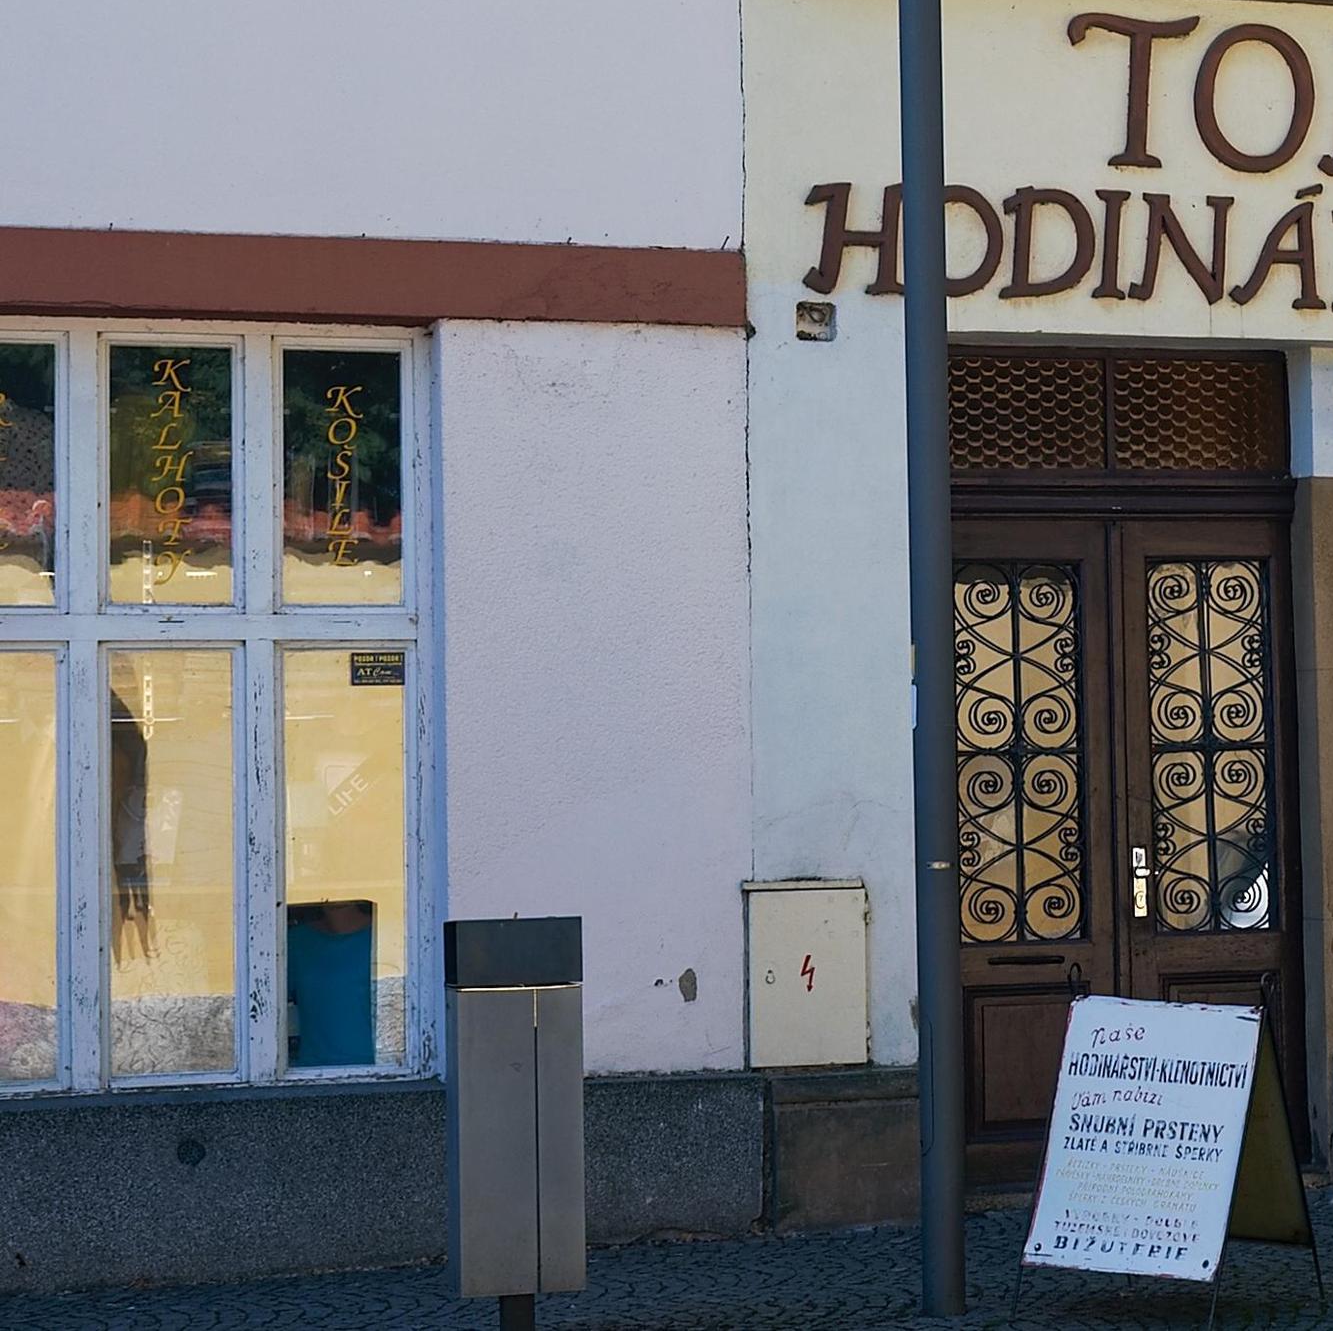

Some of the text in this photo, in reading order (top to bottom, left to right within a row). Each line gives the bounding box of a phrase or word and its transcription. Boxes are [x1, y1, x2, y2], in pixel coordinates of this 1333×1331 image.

[151, 358, 193, 586] KALHOTY
[324, 385, 364, 567] KOŠILE
[1142, 1118, 1225, 1144] PRSTENY
[1053, 1234, 1189, 1261] BIŽUTERIE
